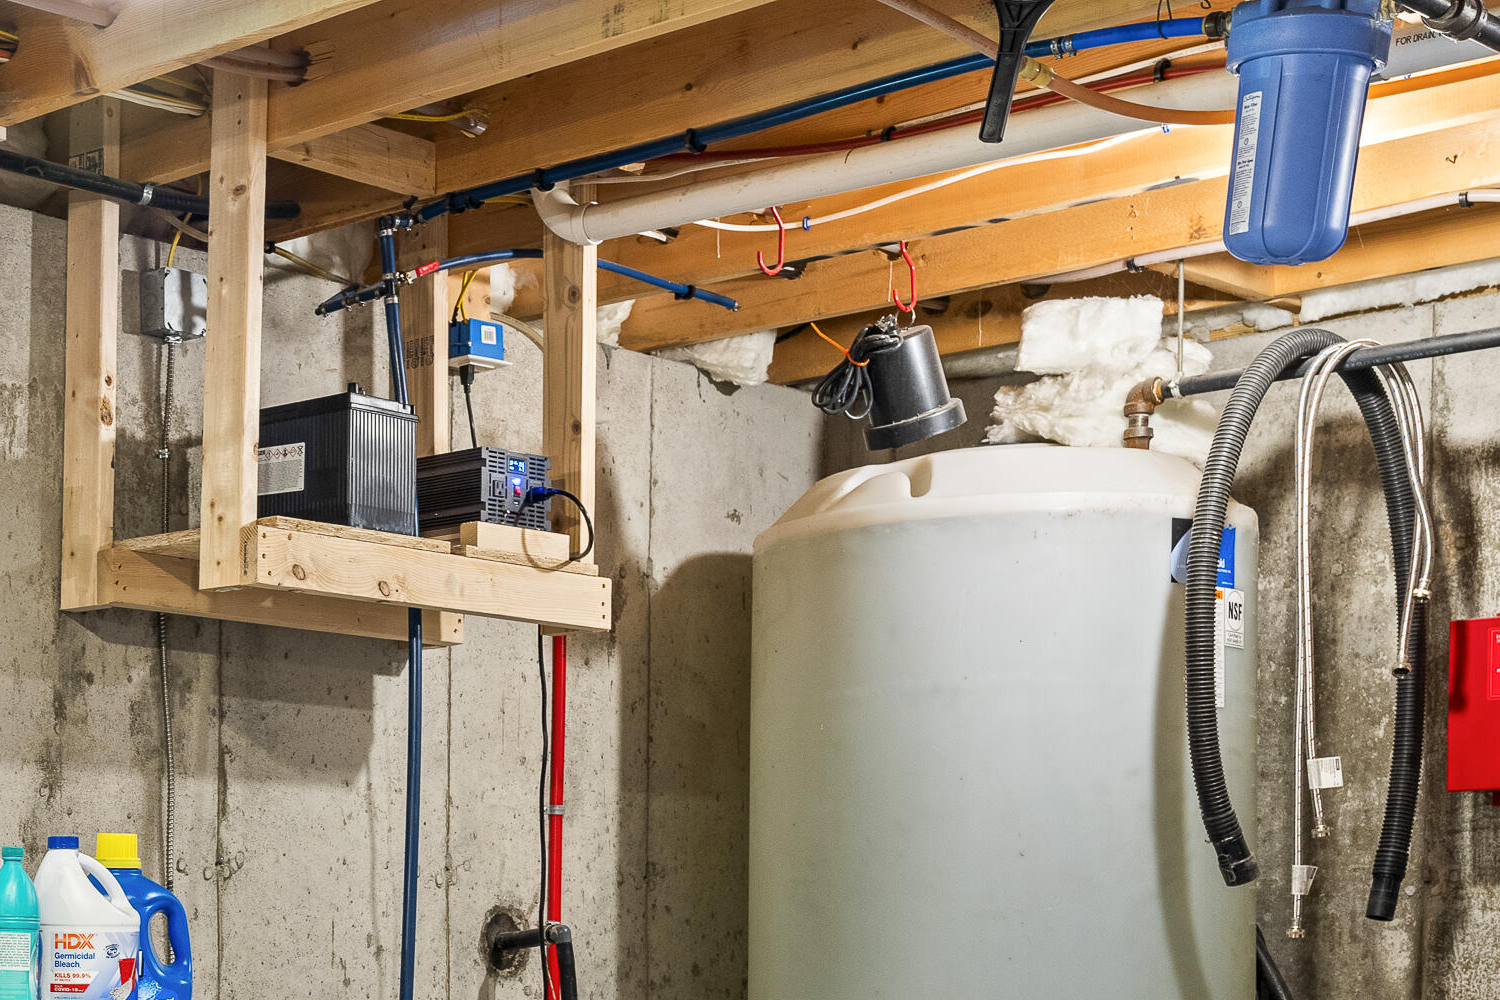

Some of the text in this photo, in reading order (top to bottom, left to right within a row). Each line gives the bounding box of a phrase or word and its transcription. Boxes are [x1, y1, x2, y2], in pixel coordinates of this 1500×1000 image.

[1395, 35, 1411, 46] FOR
[1228, 601, 1242, 621] NSF
[54, 933, 95, 950] HDX
[54, 952, 95, 960] Germicidal
[54, 960, 80, 968] Bleach
